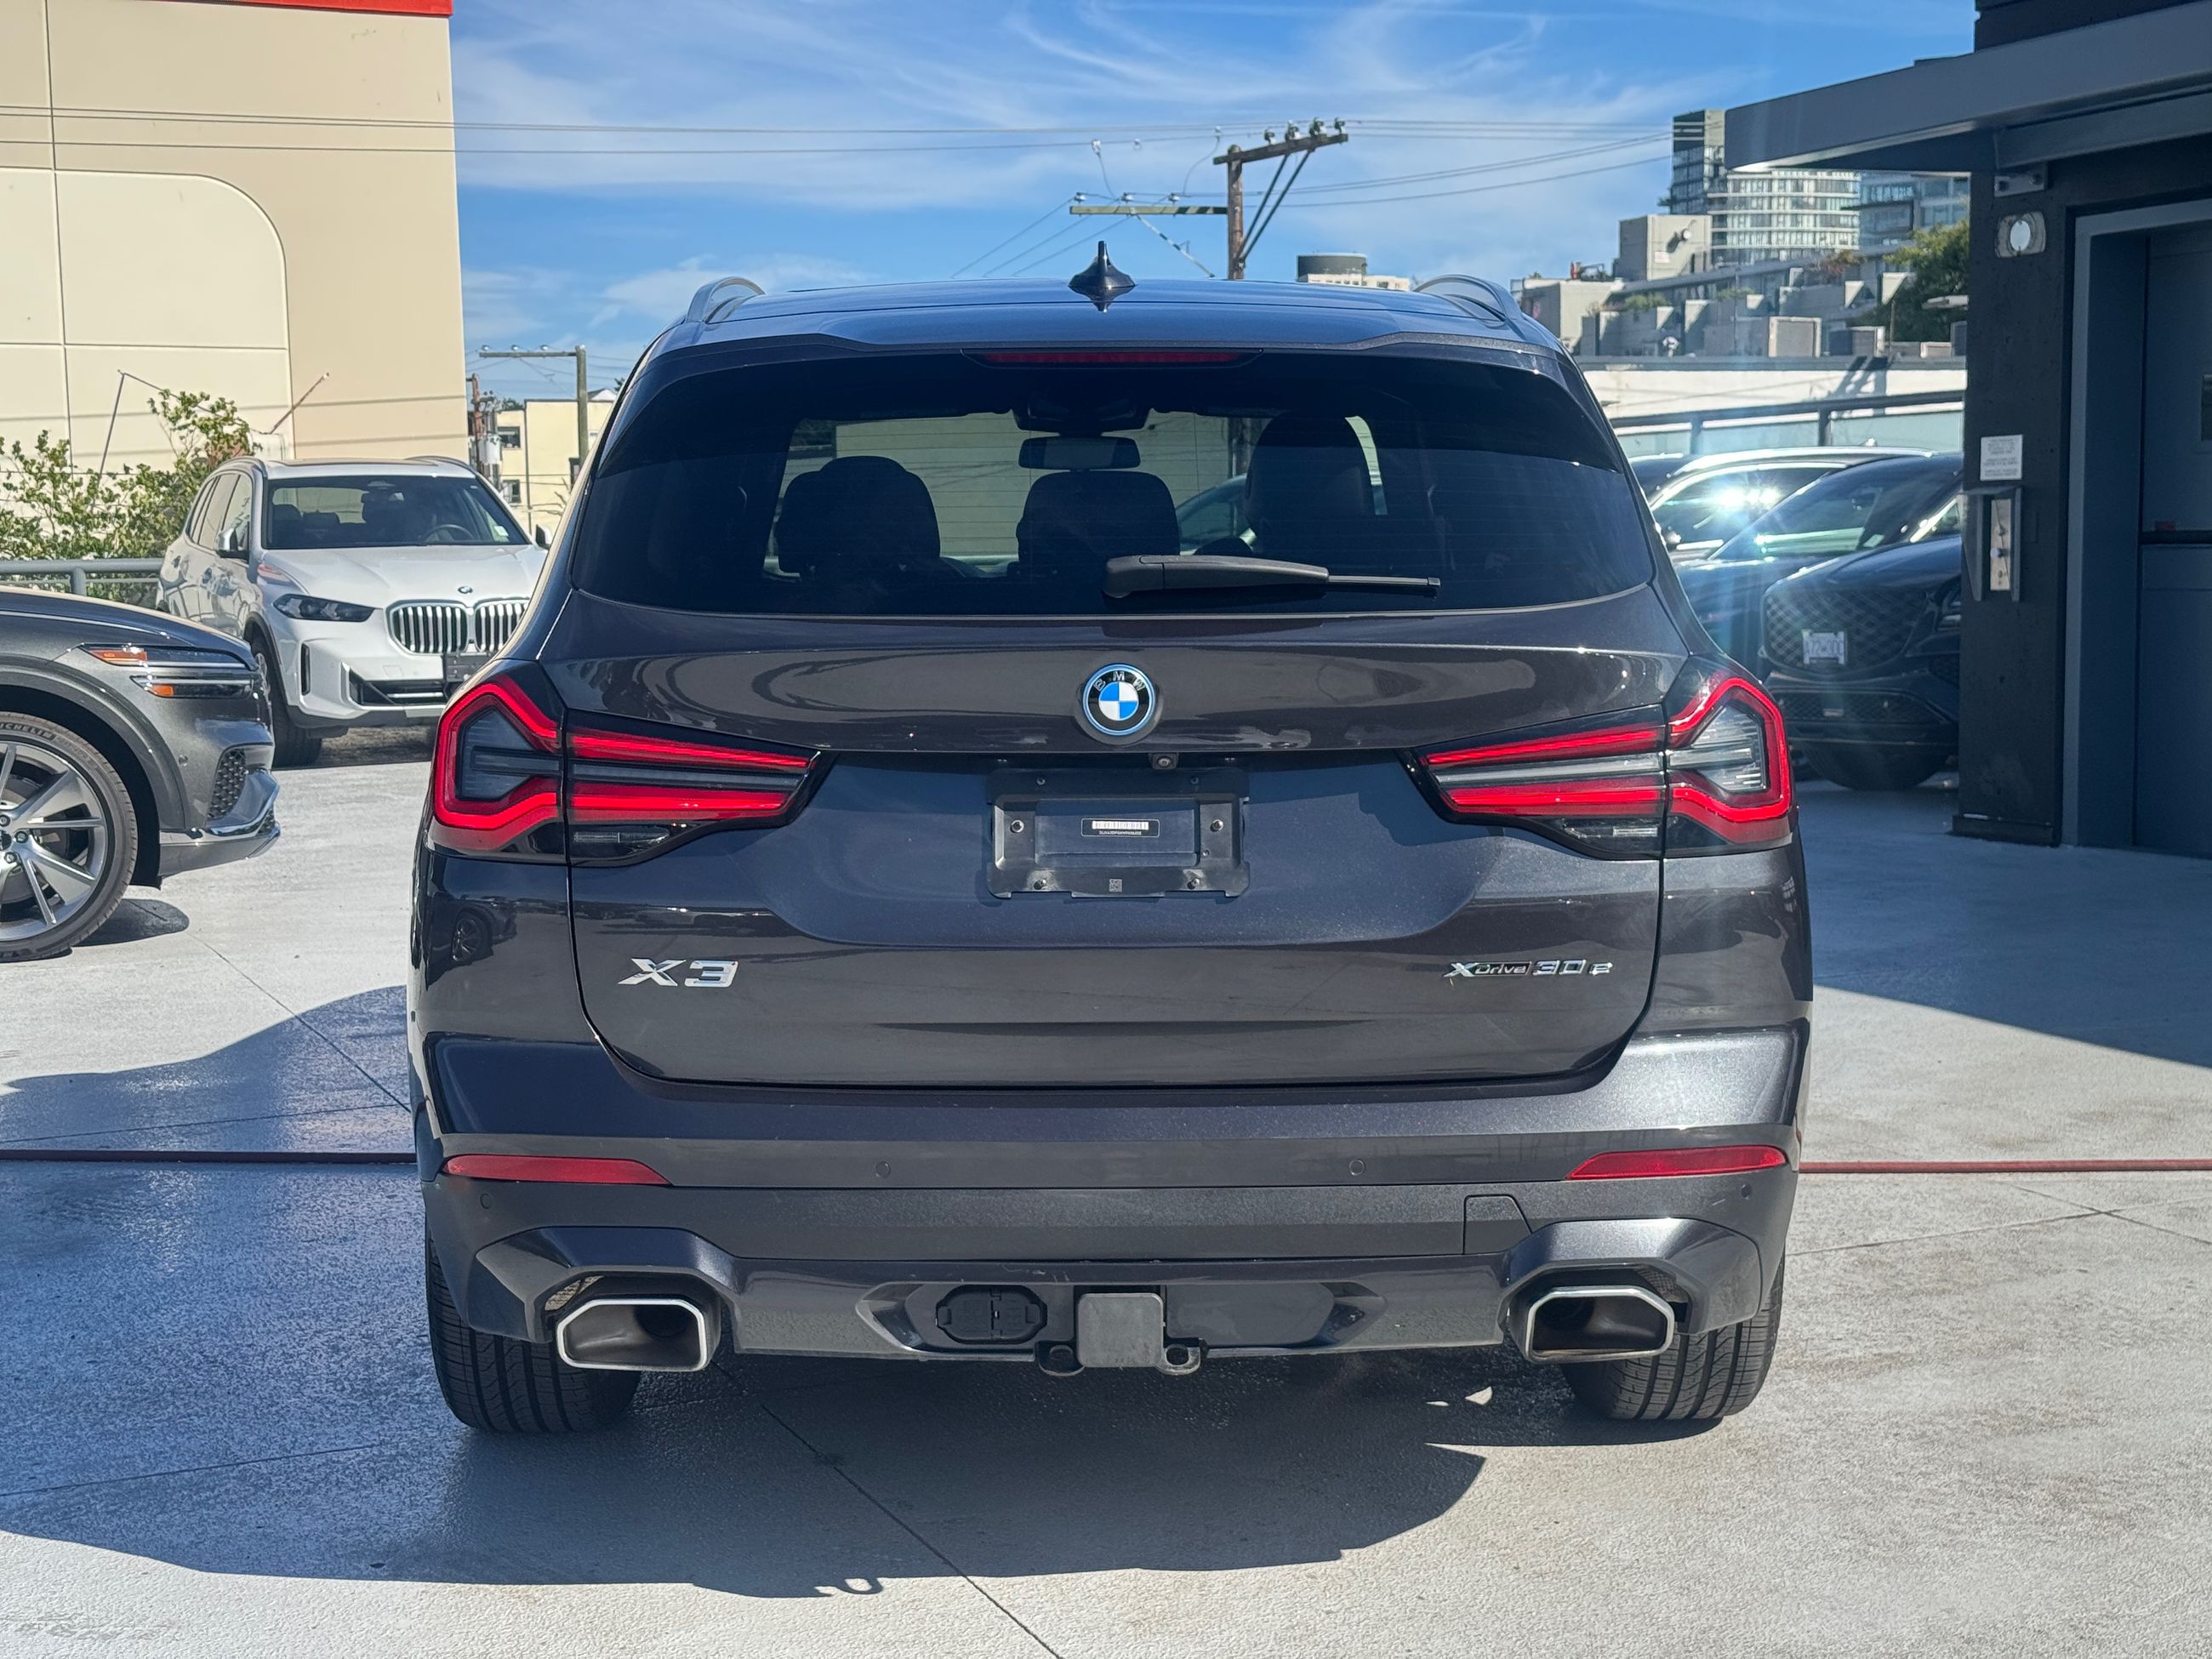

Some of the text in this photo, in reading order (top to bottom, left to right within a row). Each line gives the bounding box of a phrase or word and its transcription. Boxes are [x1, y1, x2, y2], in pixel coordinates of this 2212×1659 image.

[1093, 670, 1145, 691] BMW
[0, 722, 52, 738] ICHELIN
[617, 958, 738, 987] X3
